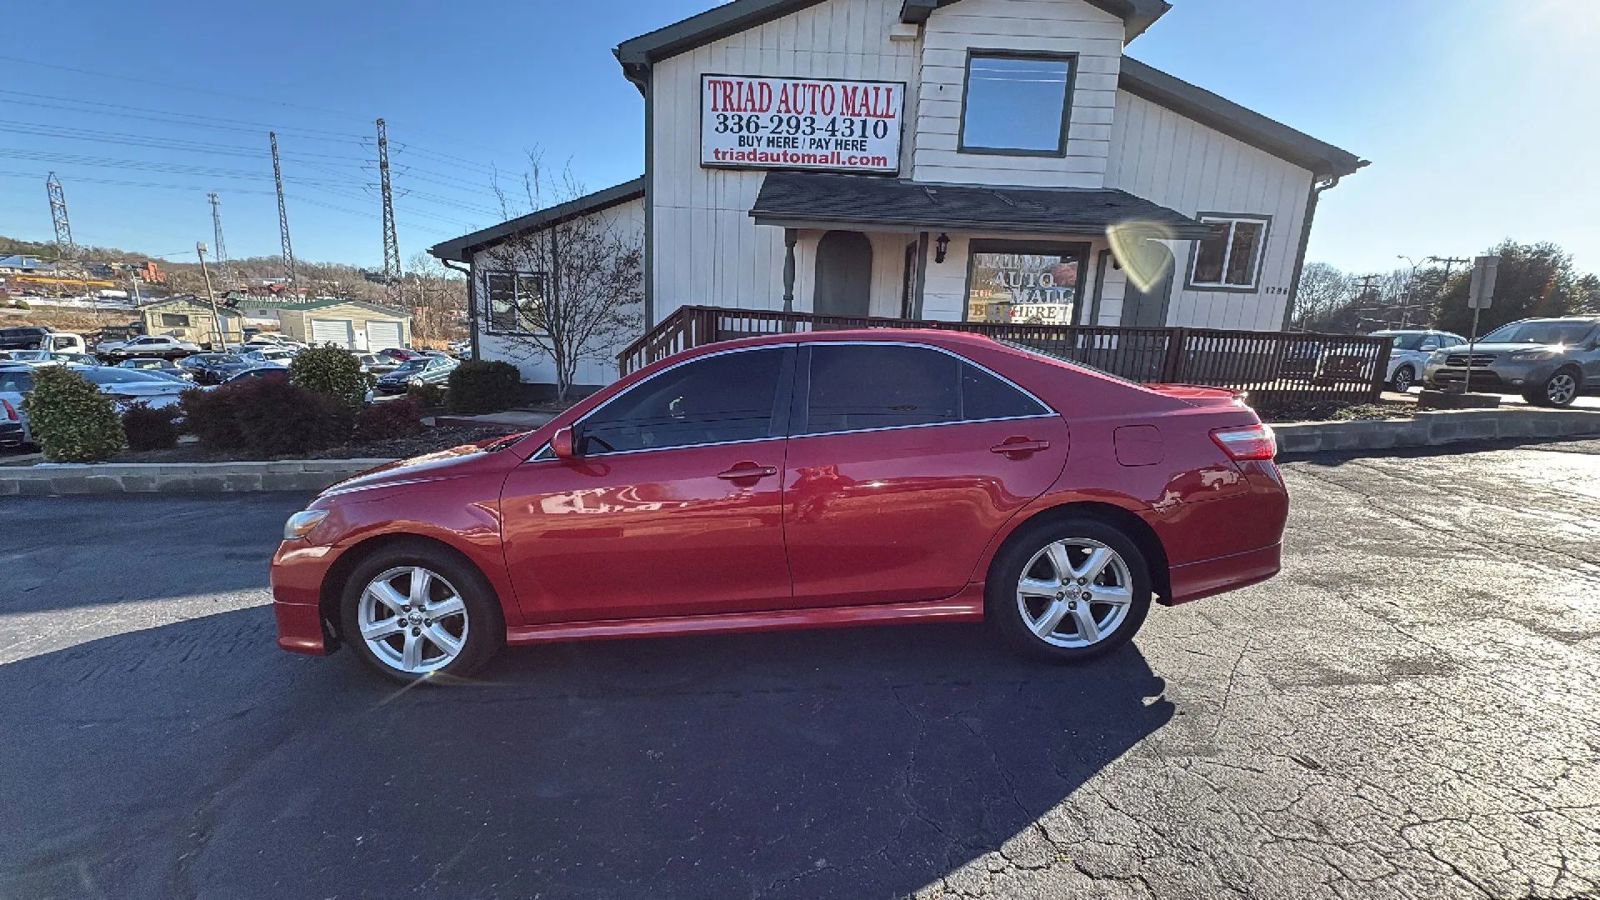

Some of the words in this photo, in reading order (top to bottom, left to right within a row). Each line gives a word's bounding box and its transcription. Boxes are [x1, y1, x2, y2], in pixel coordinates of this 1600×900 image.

[708, 80, 772, 113] TRIAD
[777, 83, 835, 116] AUTO
[840, 85, 896, 119] MALL
[714, 113, 888, 139] 336-293-4310
[738, 135, 763, 148] BUY
[767, 136, 799, 149] HERE
[809, 138, 831, 150] PAY
[835, 139, 867, 152] HERE
[713, 148, 888, 167] triadautomall.com
[994, 271, 1055, 288] AUTO
[1010, 288, 1071, 304] MALL
